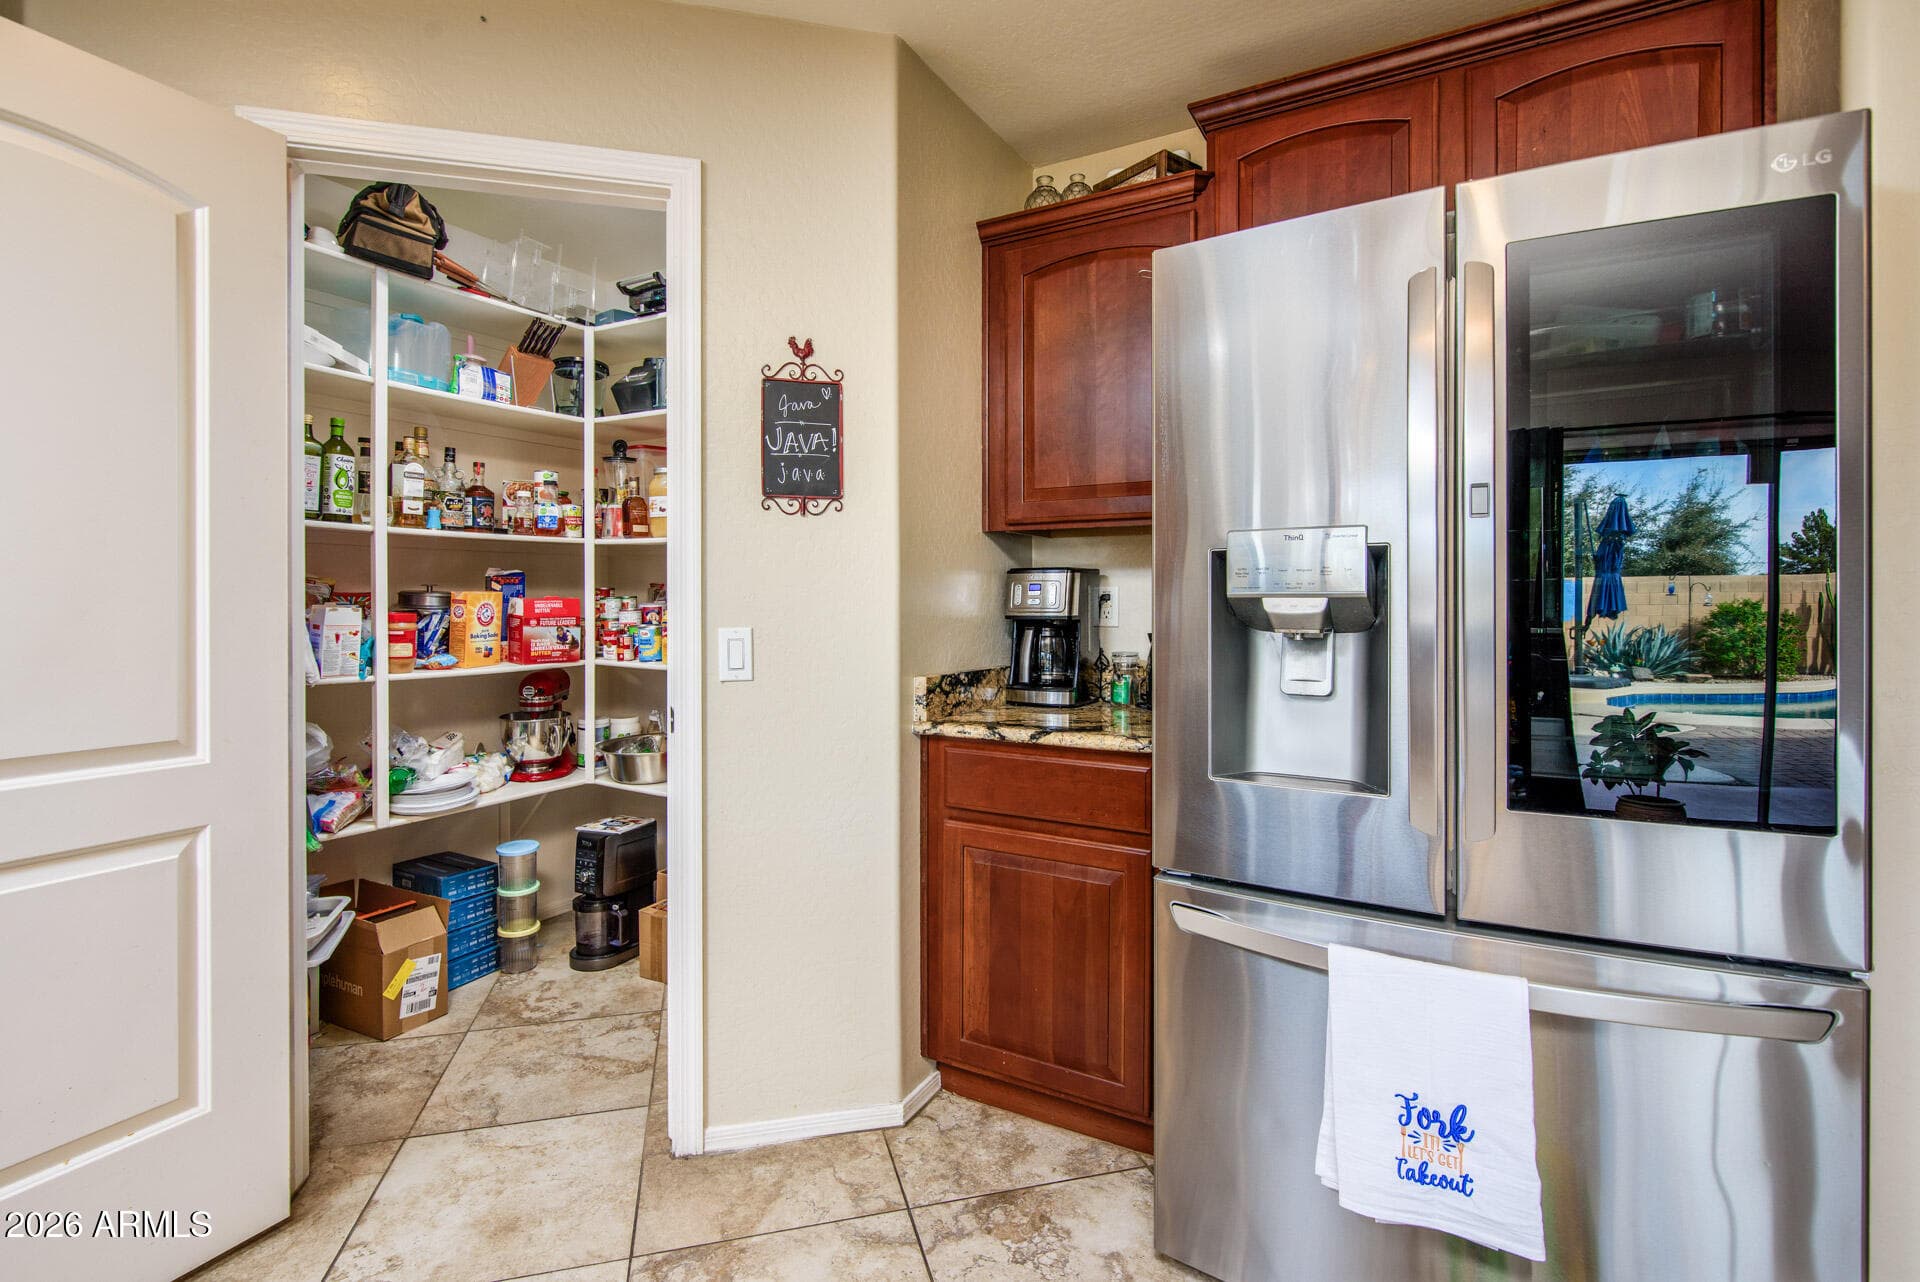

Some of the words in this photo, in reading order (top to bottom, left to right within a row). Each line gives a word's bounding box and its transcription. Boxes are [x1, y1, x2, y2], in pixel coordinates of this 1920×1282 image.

[1802, 149, 1833, 166] LG
[765, 426, 837, 454] JAVA!
[777, 462, 825, 484] java
[1283, 533, 1304, 541] ThinQ
[470, 633, 488, 641] Baking
[321, 972, 363, 997] plehuman
[1394, 1092, 1476, 1144] Fork
[1437, 1154, 1459, 1170] GET
[1395, 1156, 1475, 1198] Takeout
